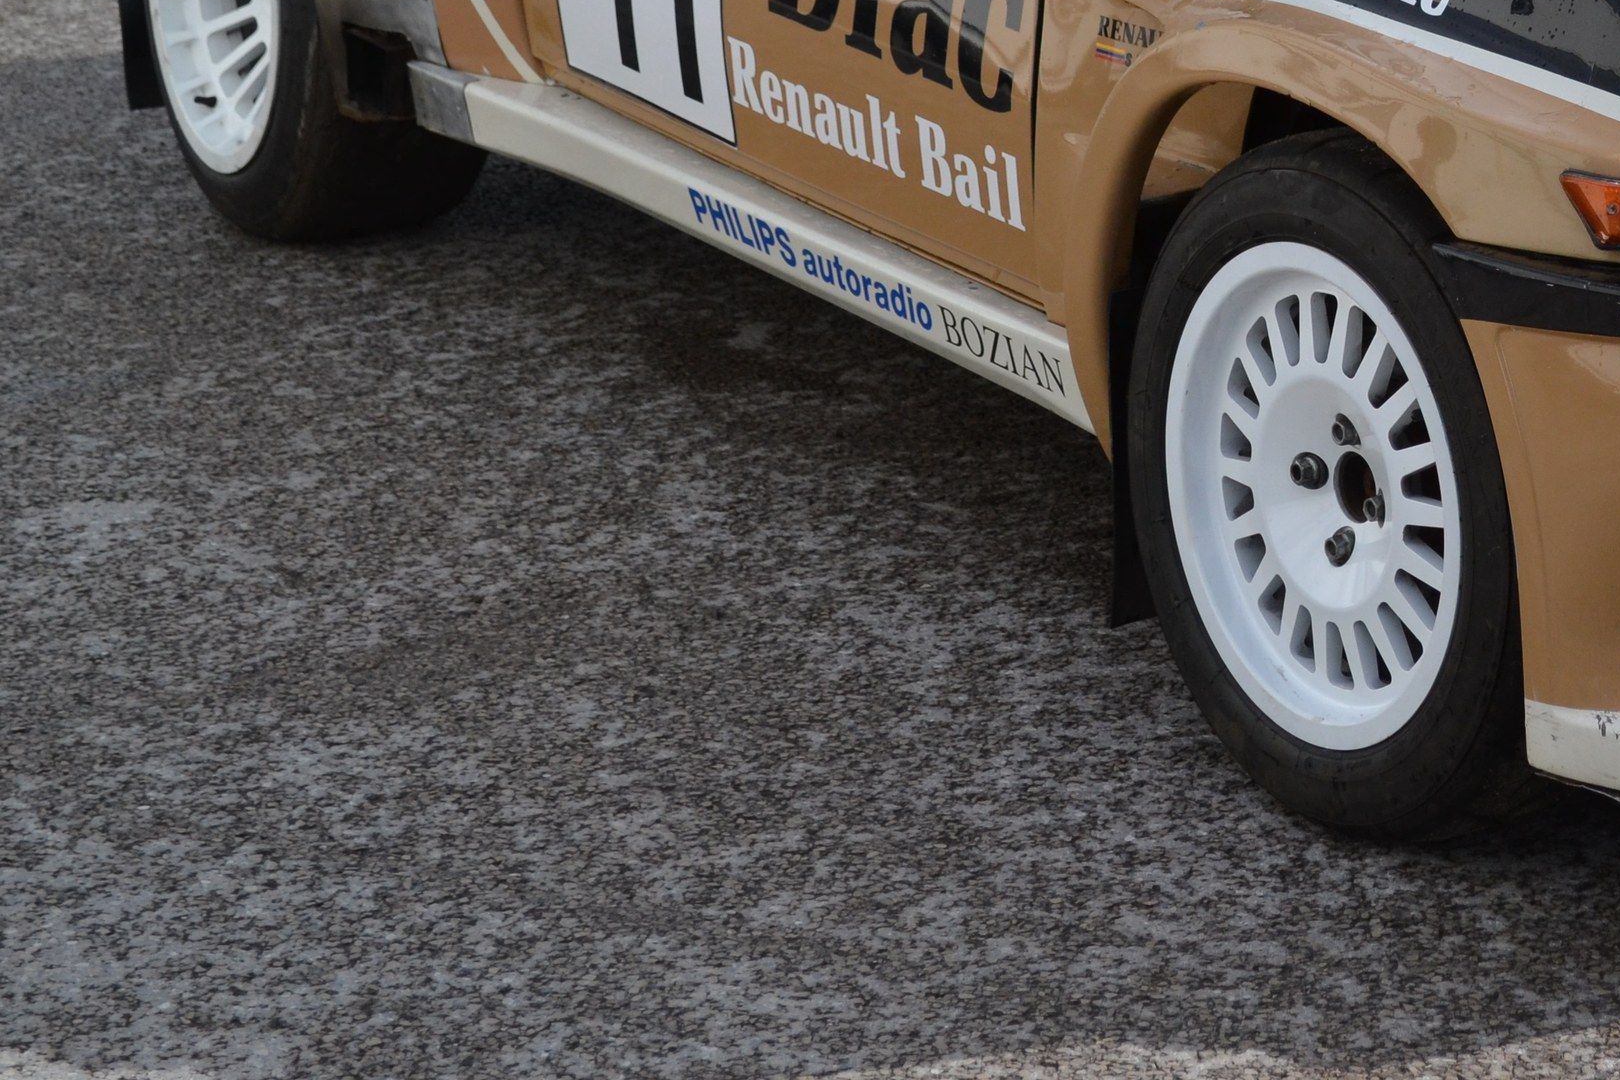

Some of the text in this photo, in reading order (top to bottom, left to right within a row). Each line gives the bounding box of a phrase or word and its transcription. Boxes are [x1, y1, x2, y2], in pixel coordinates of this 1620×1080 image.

[727, 35, 1027, 233] Renault Bail
[687, 186, 1068, 399] PHILIPS autoradio BOZIAN
